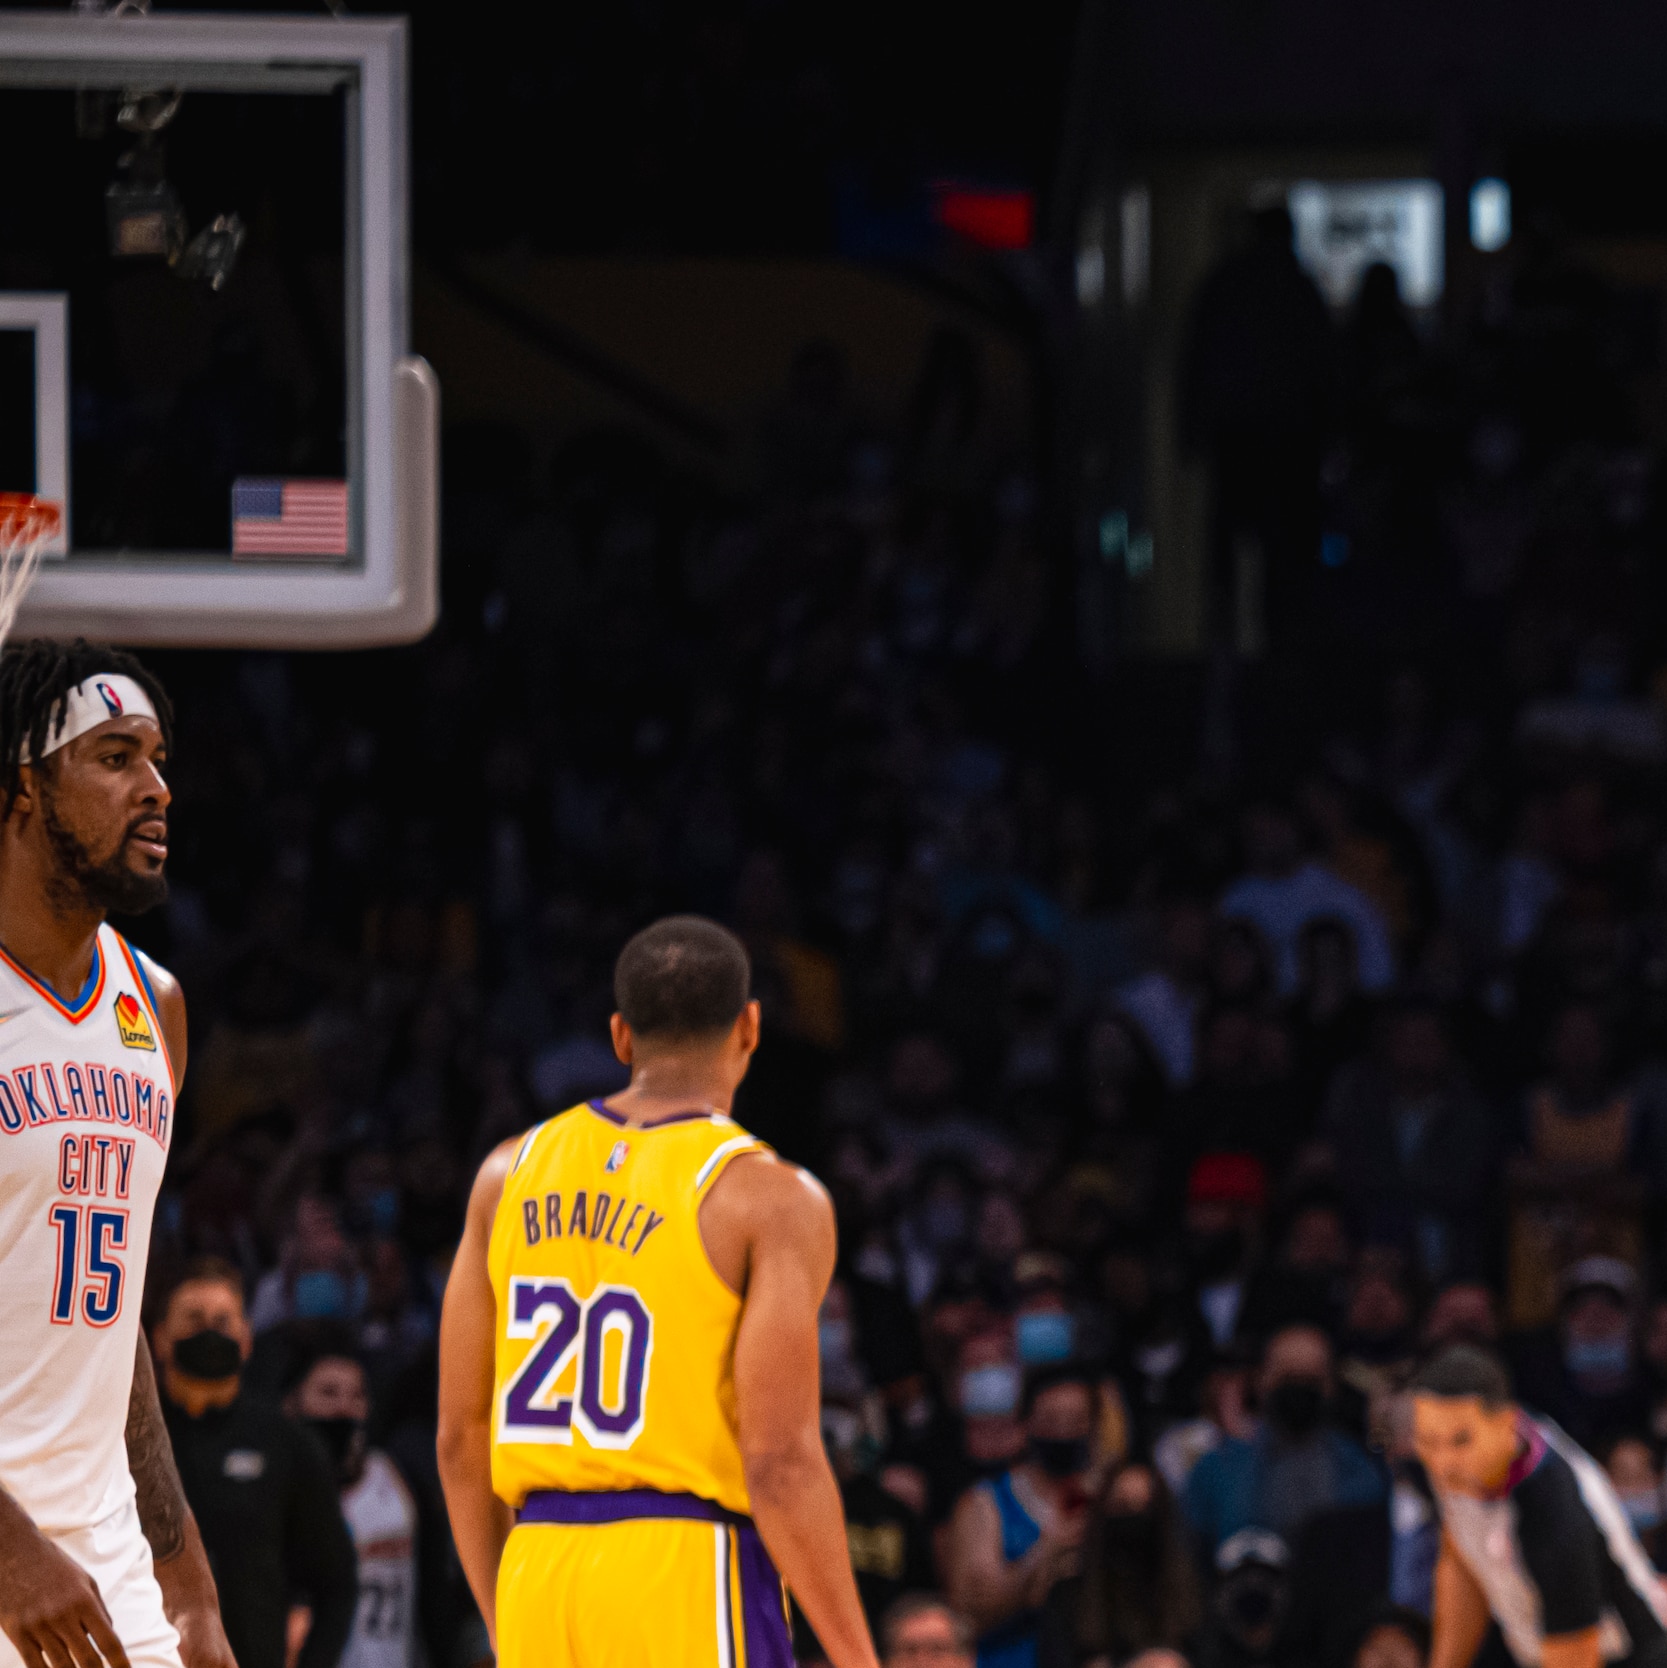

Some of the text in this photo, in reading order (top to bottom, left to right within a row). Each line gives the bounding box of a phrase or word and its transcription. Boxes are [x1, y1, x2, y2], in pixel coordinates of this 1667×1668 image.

[0, 1062, 174, 1151] OKLAHOMA
[58, 1133, 135, 1200] CITY
[49, 1202, 129, 1329] 15
[522, 1190, 664, 1257] BRADLEY
[496, 1274, 654, 1451] 20
